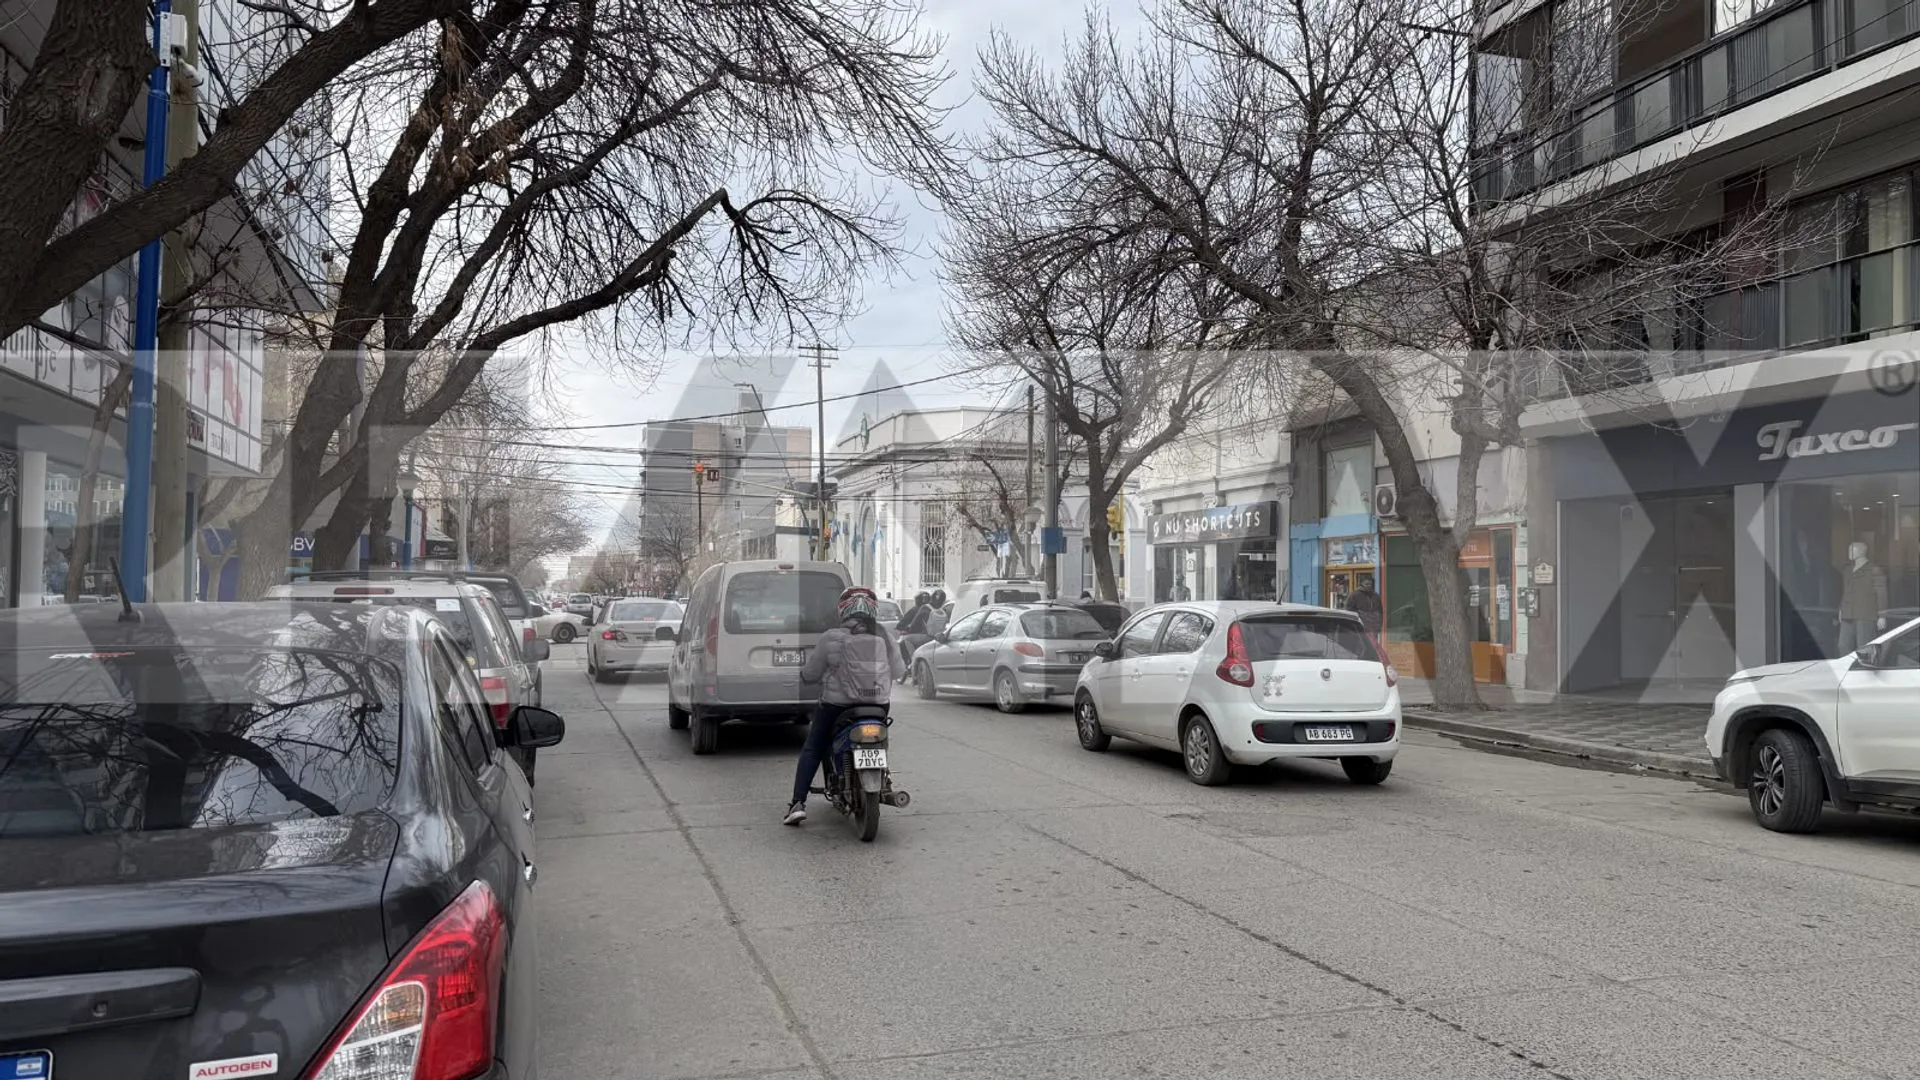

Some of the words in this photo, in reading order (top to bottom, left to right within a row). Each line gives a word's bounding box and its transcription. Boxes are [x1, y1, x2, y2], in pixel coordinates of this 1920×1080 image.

[1755, 419, 1919, 462] Taxco
[1165, 519, 1180, 535] NU
[1309, 729, 1320, 739] AB
[858, 757, 885, 767] 7DYC
[196, 1060, 273, 1078] AUTOGEN
